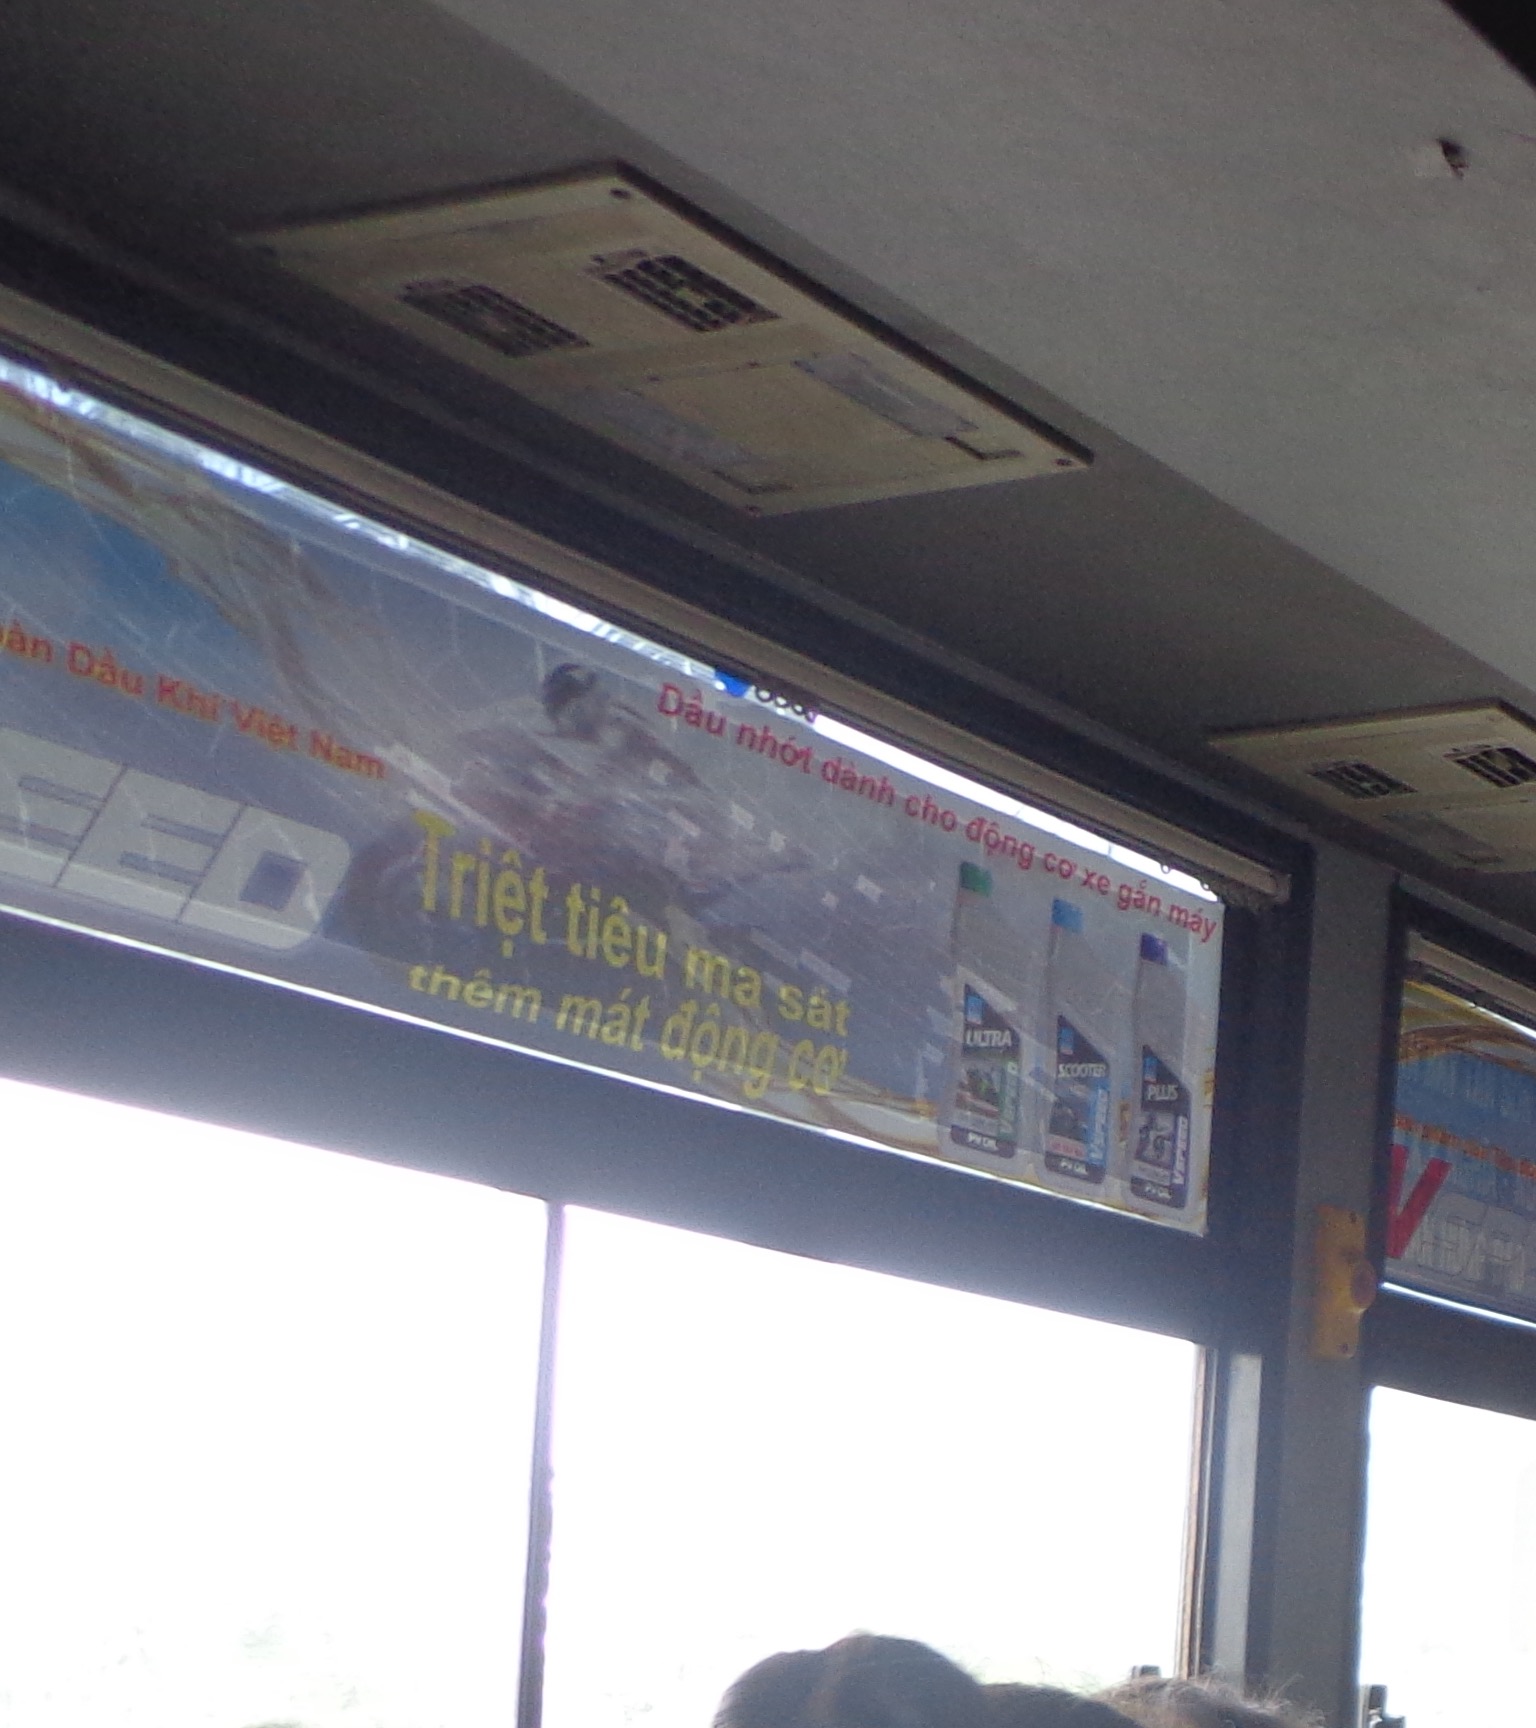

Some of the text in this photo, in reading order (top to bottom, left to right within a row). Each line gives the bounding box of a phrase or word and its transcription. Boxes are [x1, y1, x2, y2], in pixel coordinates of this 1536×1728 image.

[0, 618, 387, 780] àn Dầu Khí Việt Nam
[658, 682, 1217, 942] Dầu nhớt dành cho động cơ xe gắn máy
[413, 810, 549, 958] Triệt
[567, 882, 667, 979] tiêu
[685, 945, 762, 1009] ma
[409, 964, 848, 1098] thêm mát động cơ
[965, 1029, 1012, 1047] ULTRA
[1057, 1063, 1107, 1079] SCOOTER
[1147, 1084, 1179, 1100] PLUS
